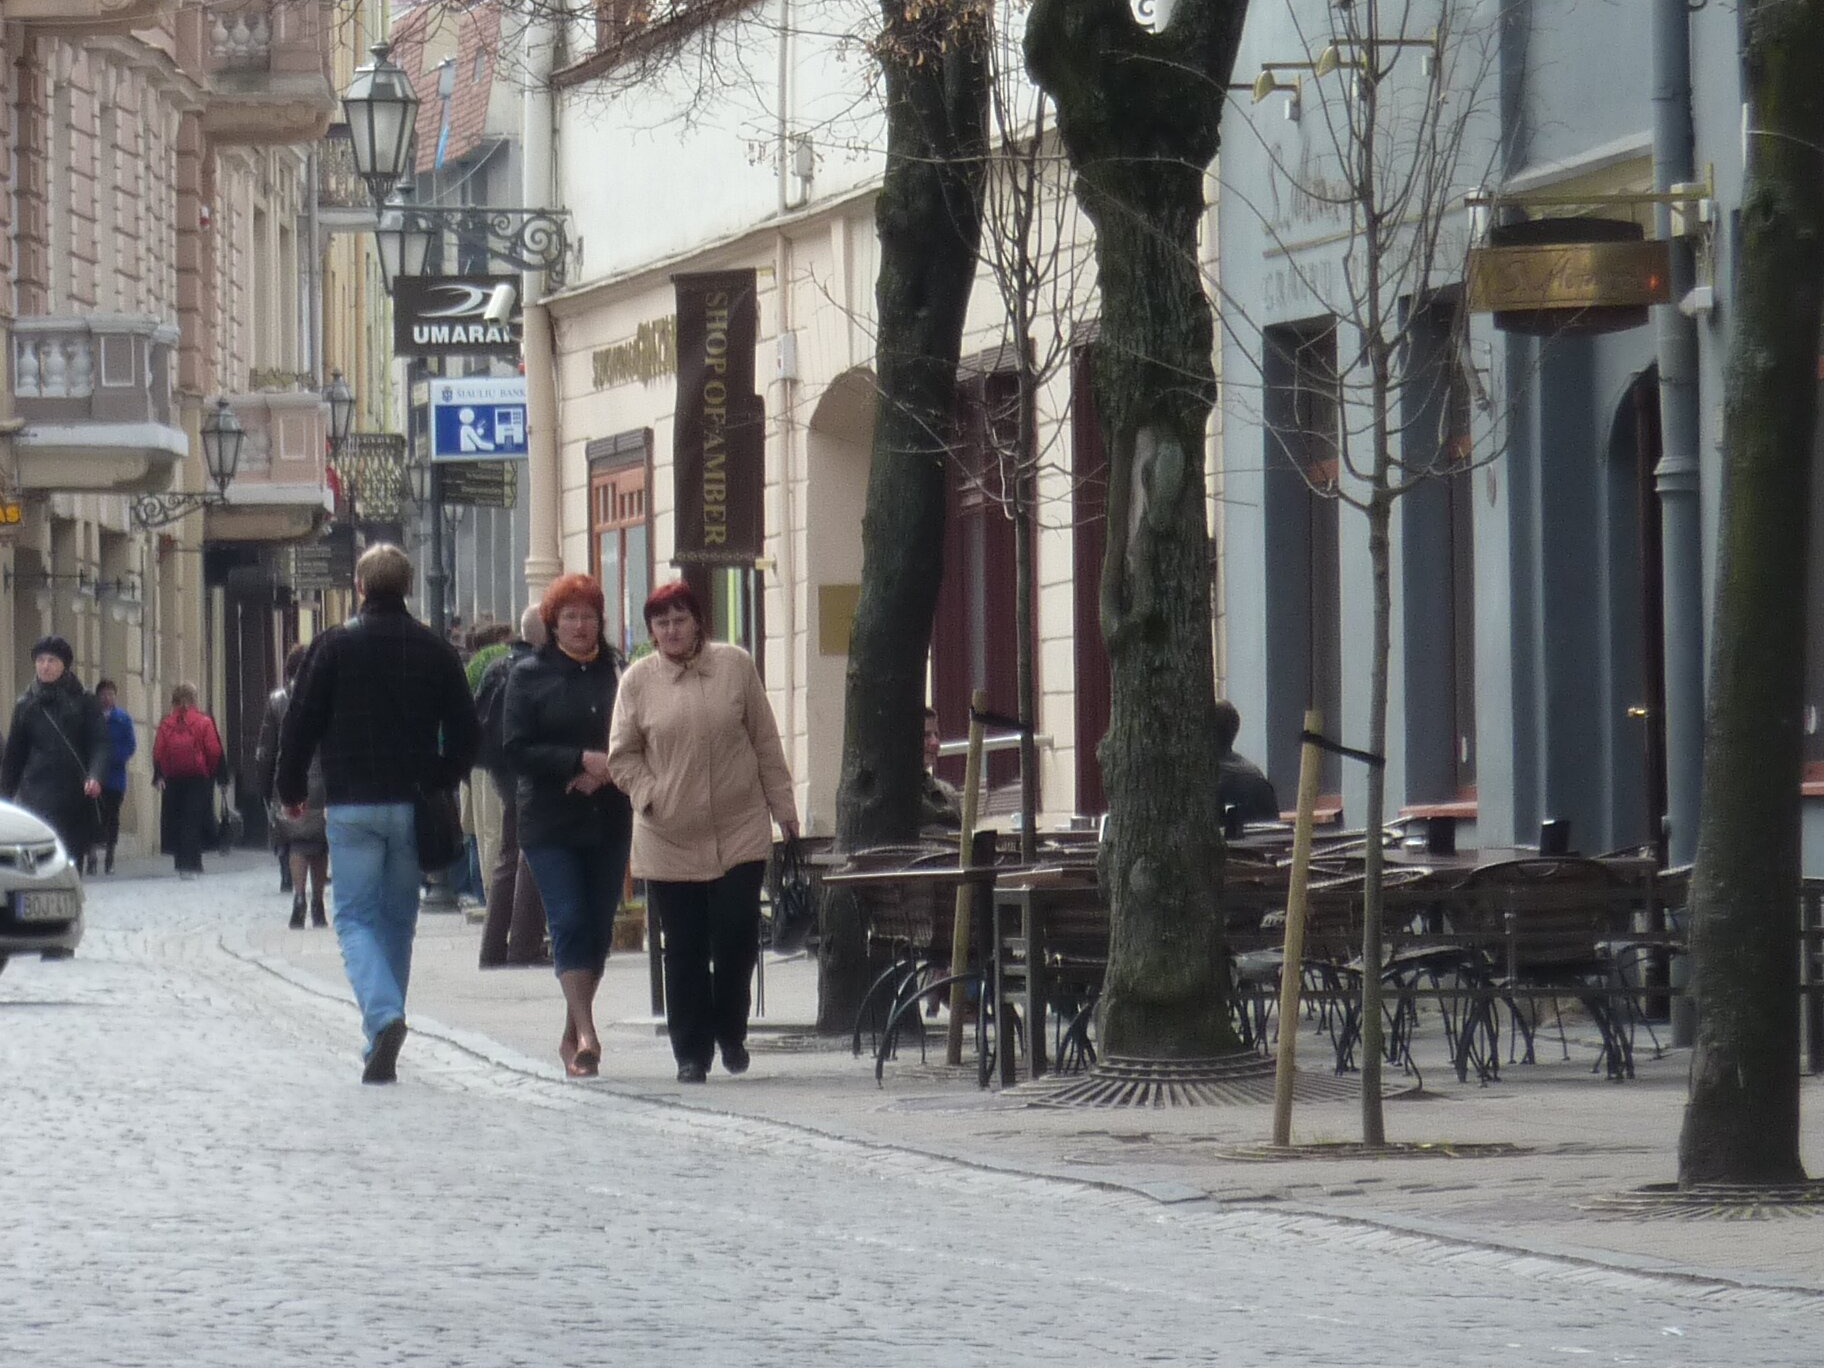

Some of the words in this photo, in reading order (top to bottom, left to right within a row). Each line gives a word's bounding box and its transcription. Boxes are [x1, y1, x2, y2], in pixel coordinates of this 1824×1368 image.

[705, 291, 727, 374] SHOP
[703, 381, 726, 428] OF
[703, 430, 726, 546] AMBER
